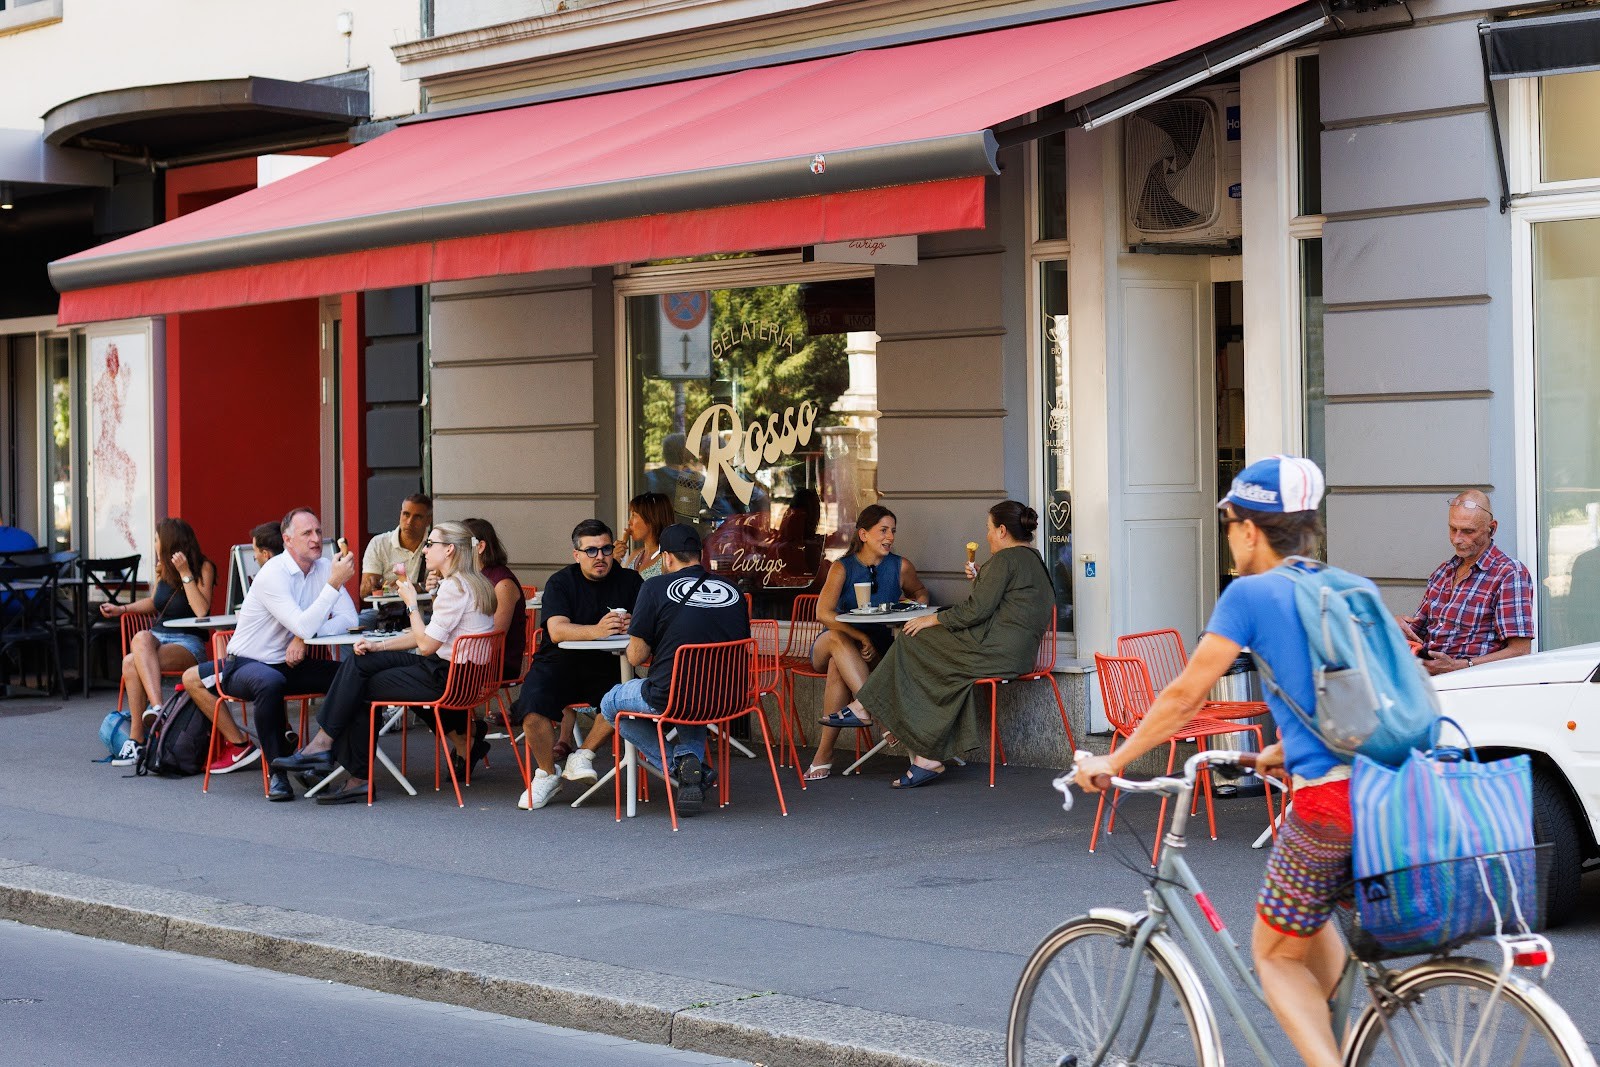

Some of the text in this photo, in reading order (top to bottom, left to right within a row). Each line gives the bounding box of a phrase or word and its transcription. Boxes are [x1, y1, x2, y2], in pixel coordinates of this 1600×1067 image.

[711, 320, 794, 359] GELATERIA
[1051, 347, 1063, 355] BIO
[685, 400, 818, 509] Rosso
[1048, 535, 1070, 543] VEGAN
[731, 548, 787, 586] Zurigo
